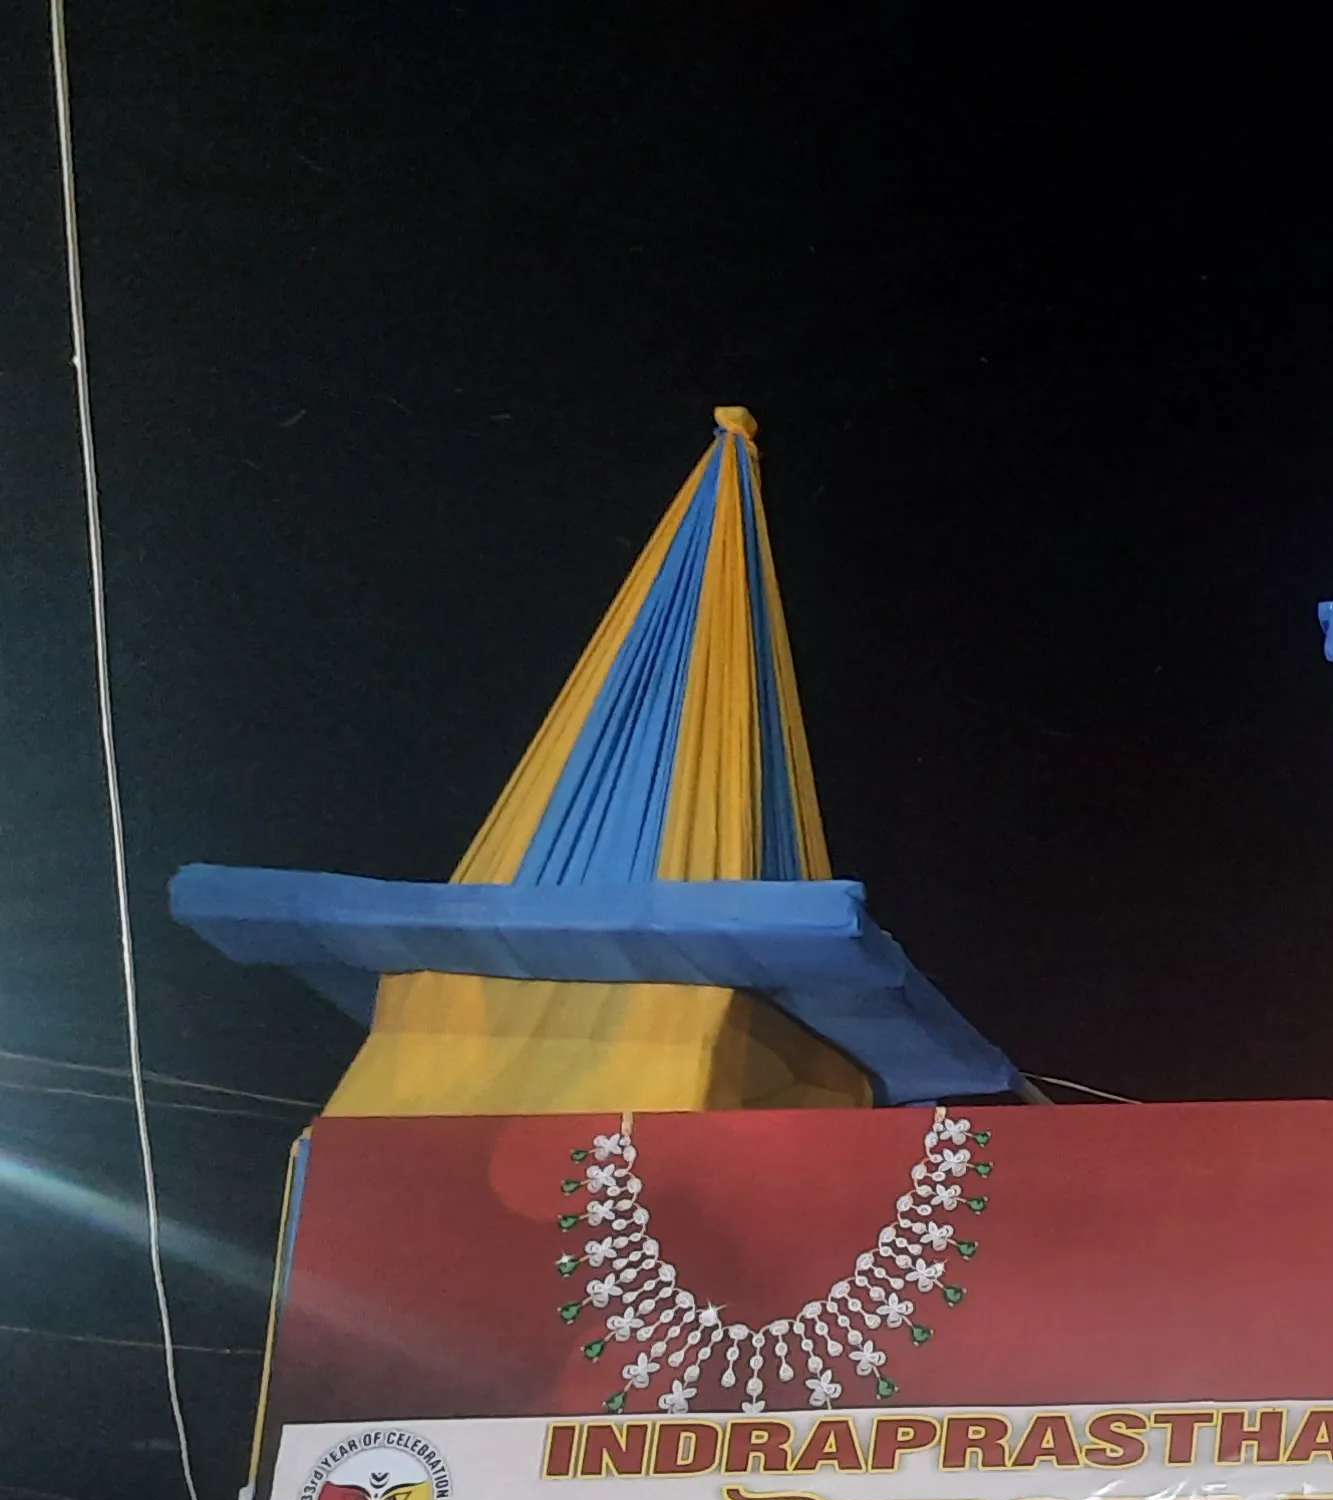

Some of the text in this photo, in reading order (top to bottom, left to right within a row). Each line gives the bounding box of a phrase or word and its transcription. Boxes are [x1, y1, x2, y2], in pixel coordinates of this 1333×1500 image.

[320, 1439, 360, 1468] YEAR
[362, 1431, 383, 1447] OF
[386, 1432, 450, 1499] CELEBRATION
